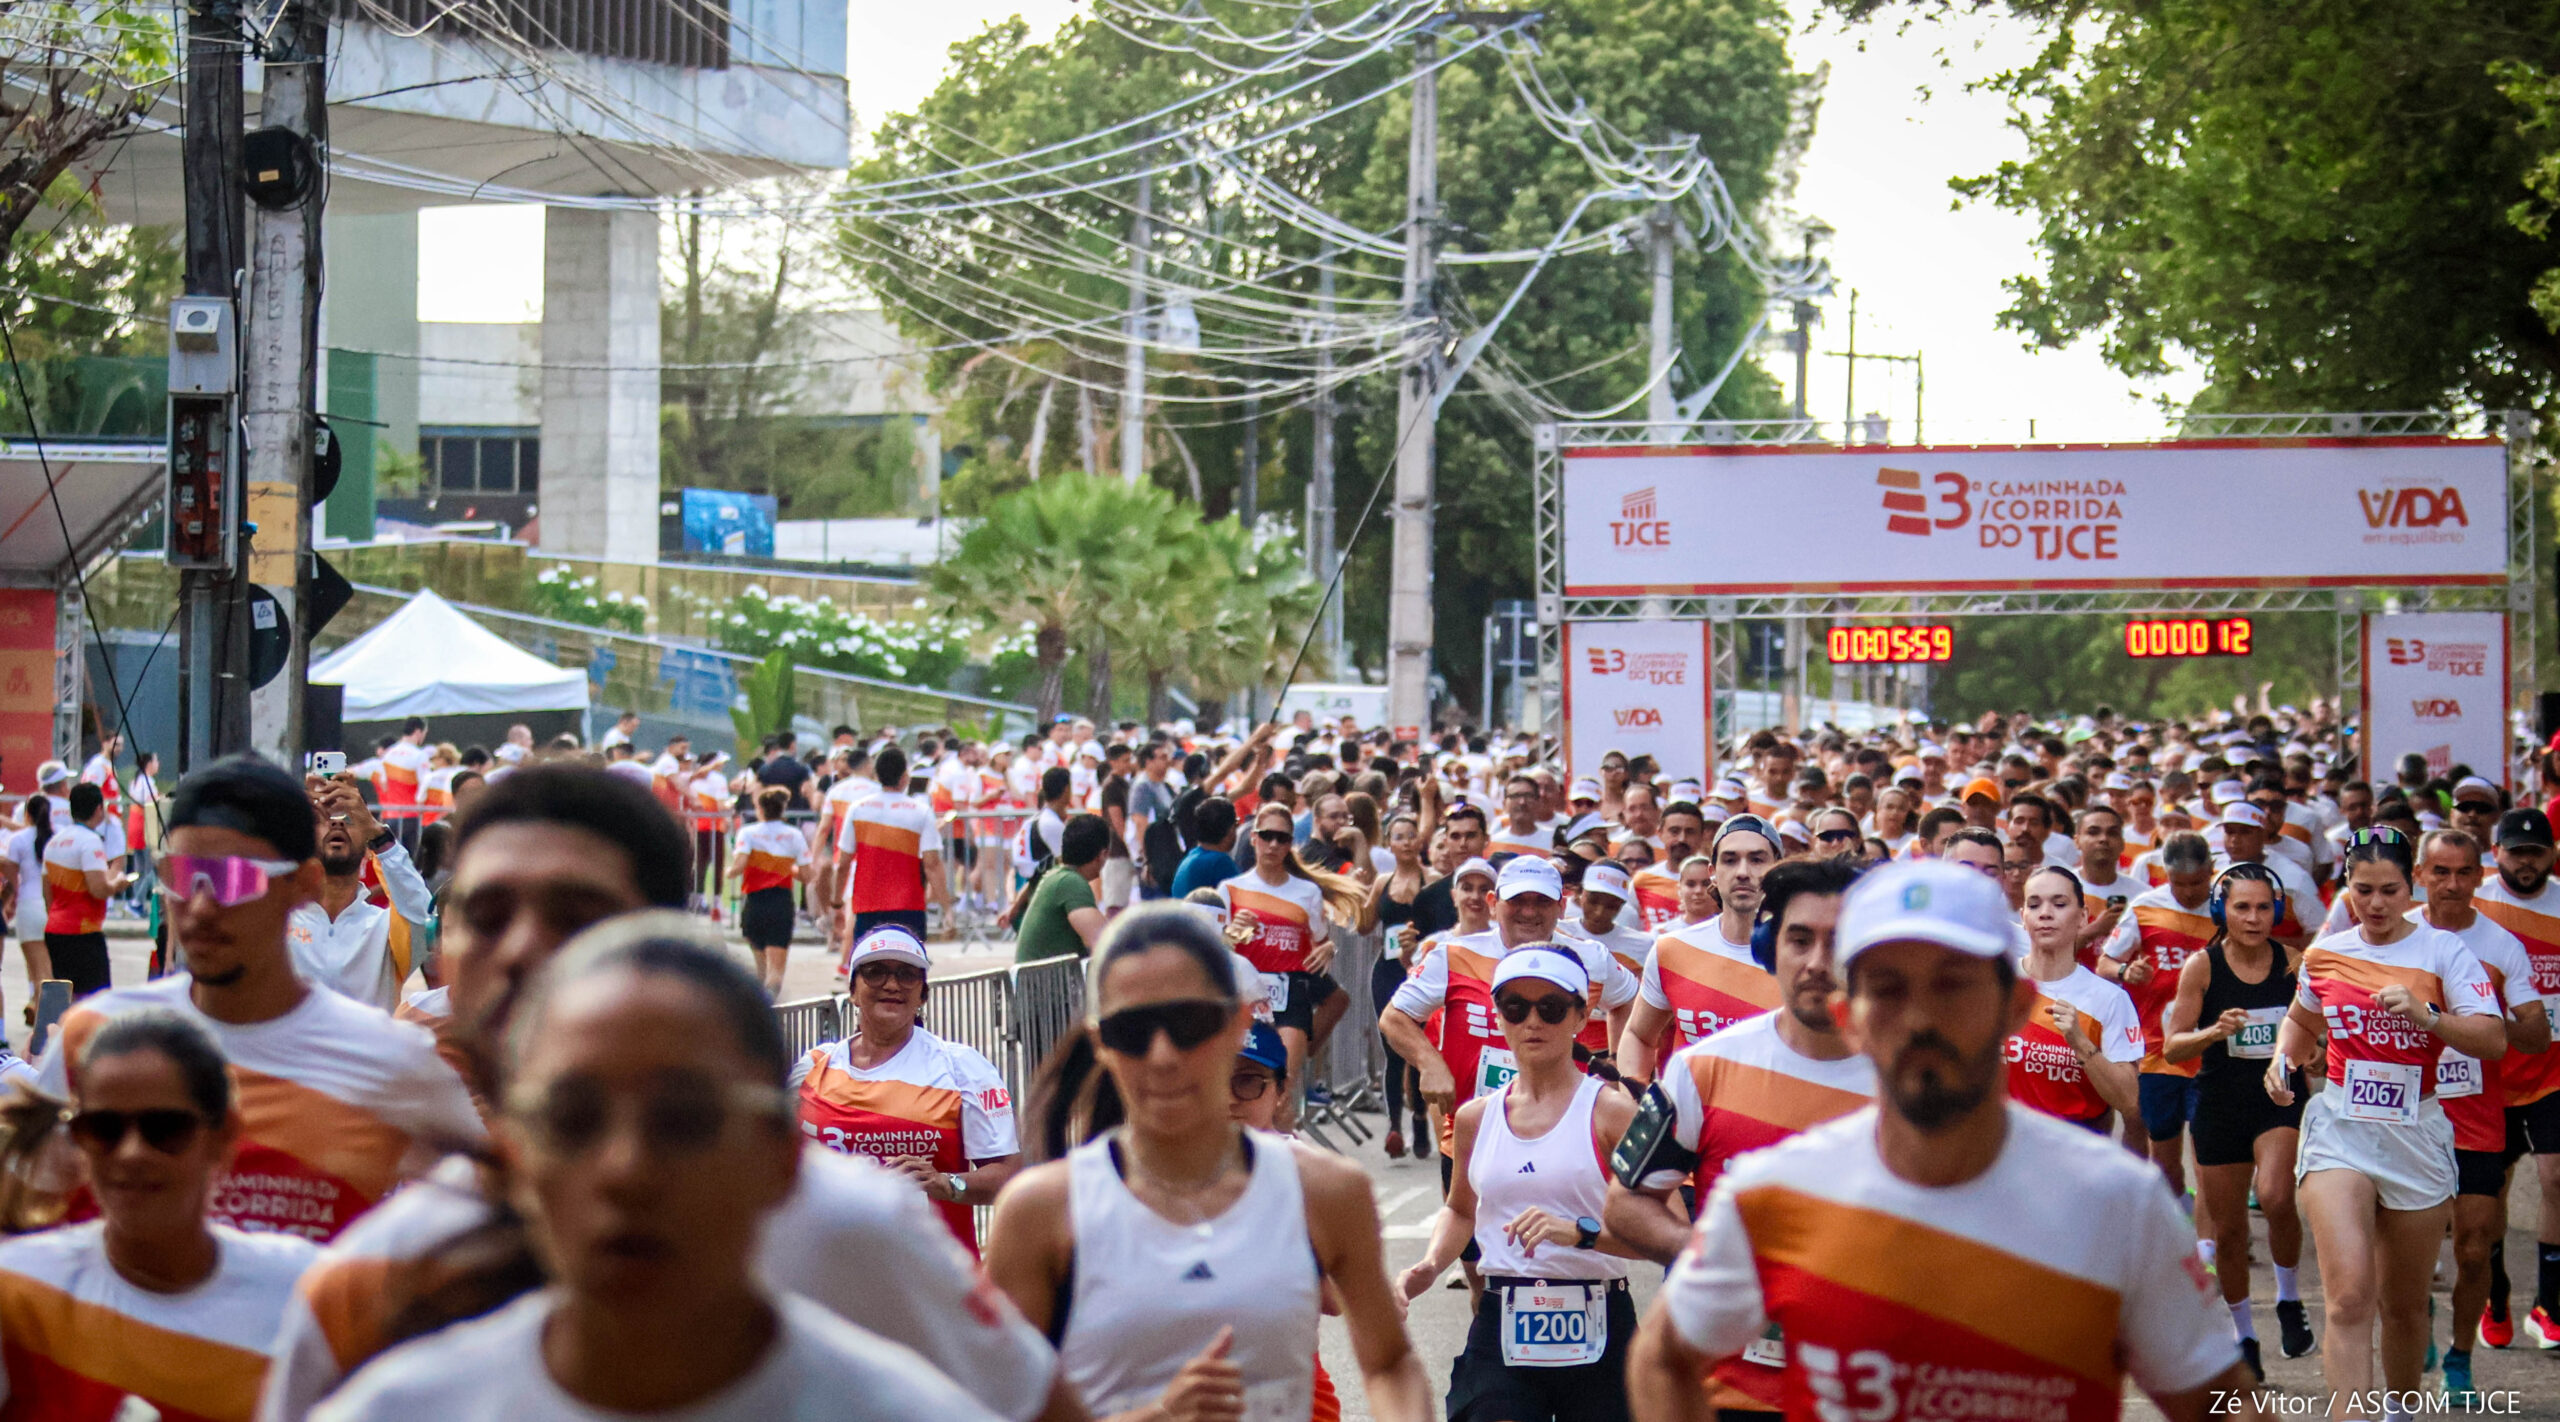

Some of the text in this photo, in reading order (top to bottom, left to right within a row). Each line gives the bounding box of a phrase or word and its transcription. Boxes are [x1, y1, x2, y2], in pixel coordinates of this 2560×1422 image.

[1988, 479, 2127, 497] CAMINHADA
[1609, 521, 1671, 546] TJCE
[1979, 523, 2119, 561] DO TJCE
[1831, 628, 1952, 662] 00:05:59
[1649, 670, 1685, 685] TJCE
[2241, 1025, 2272, 1044] 408
[2367, 1031, 2390, 1045] DO
[2025, 1061, 2082, 1083] DO TJCE
[2353, 1081, 2405, 1106] 2067
[855, 1130, 943, 1143] CAMINHADA
[1518, 1313, 1585, 1342] 1200
